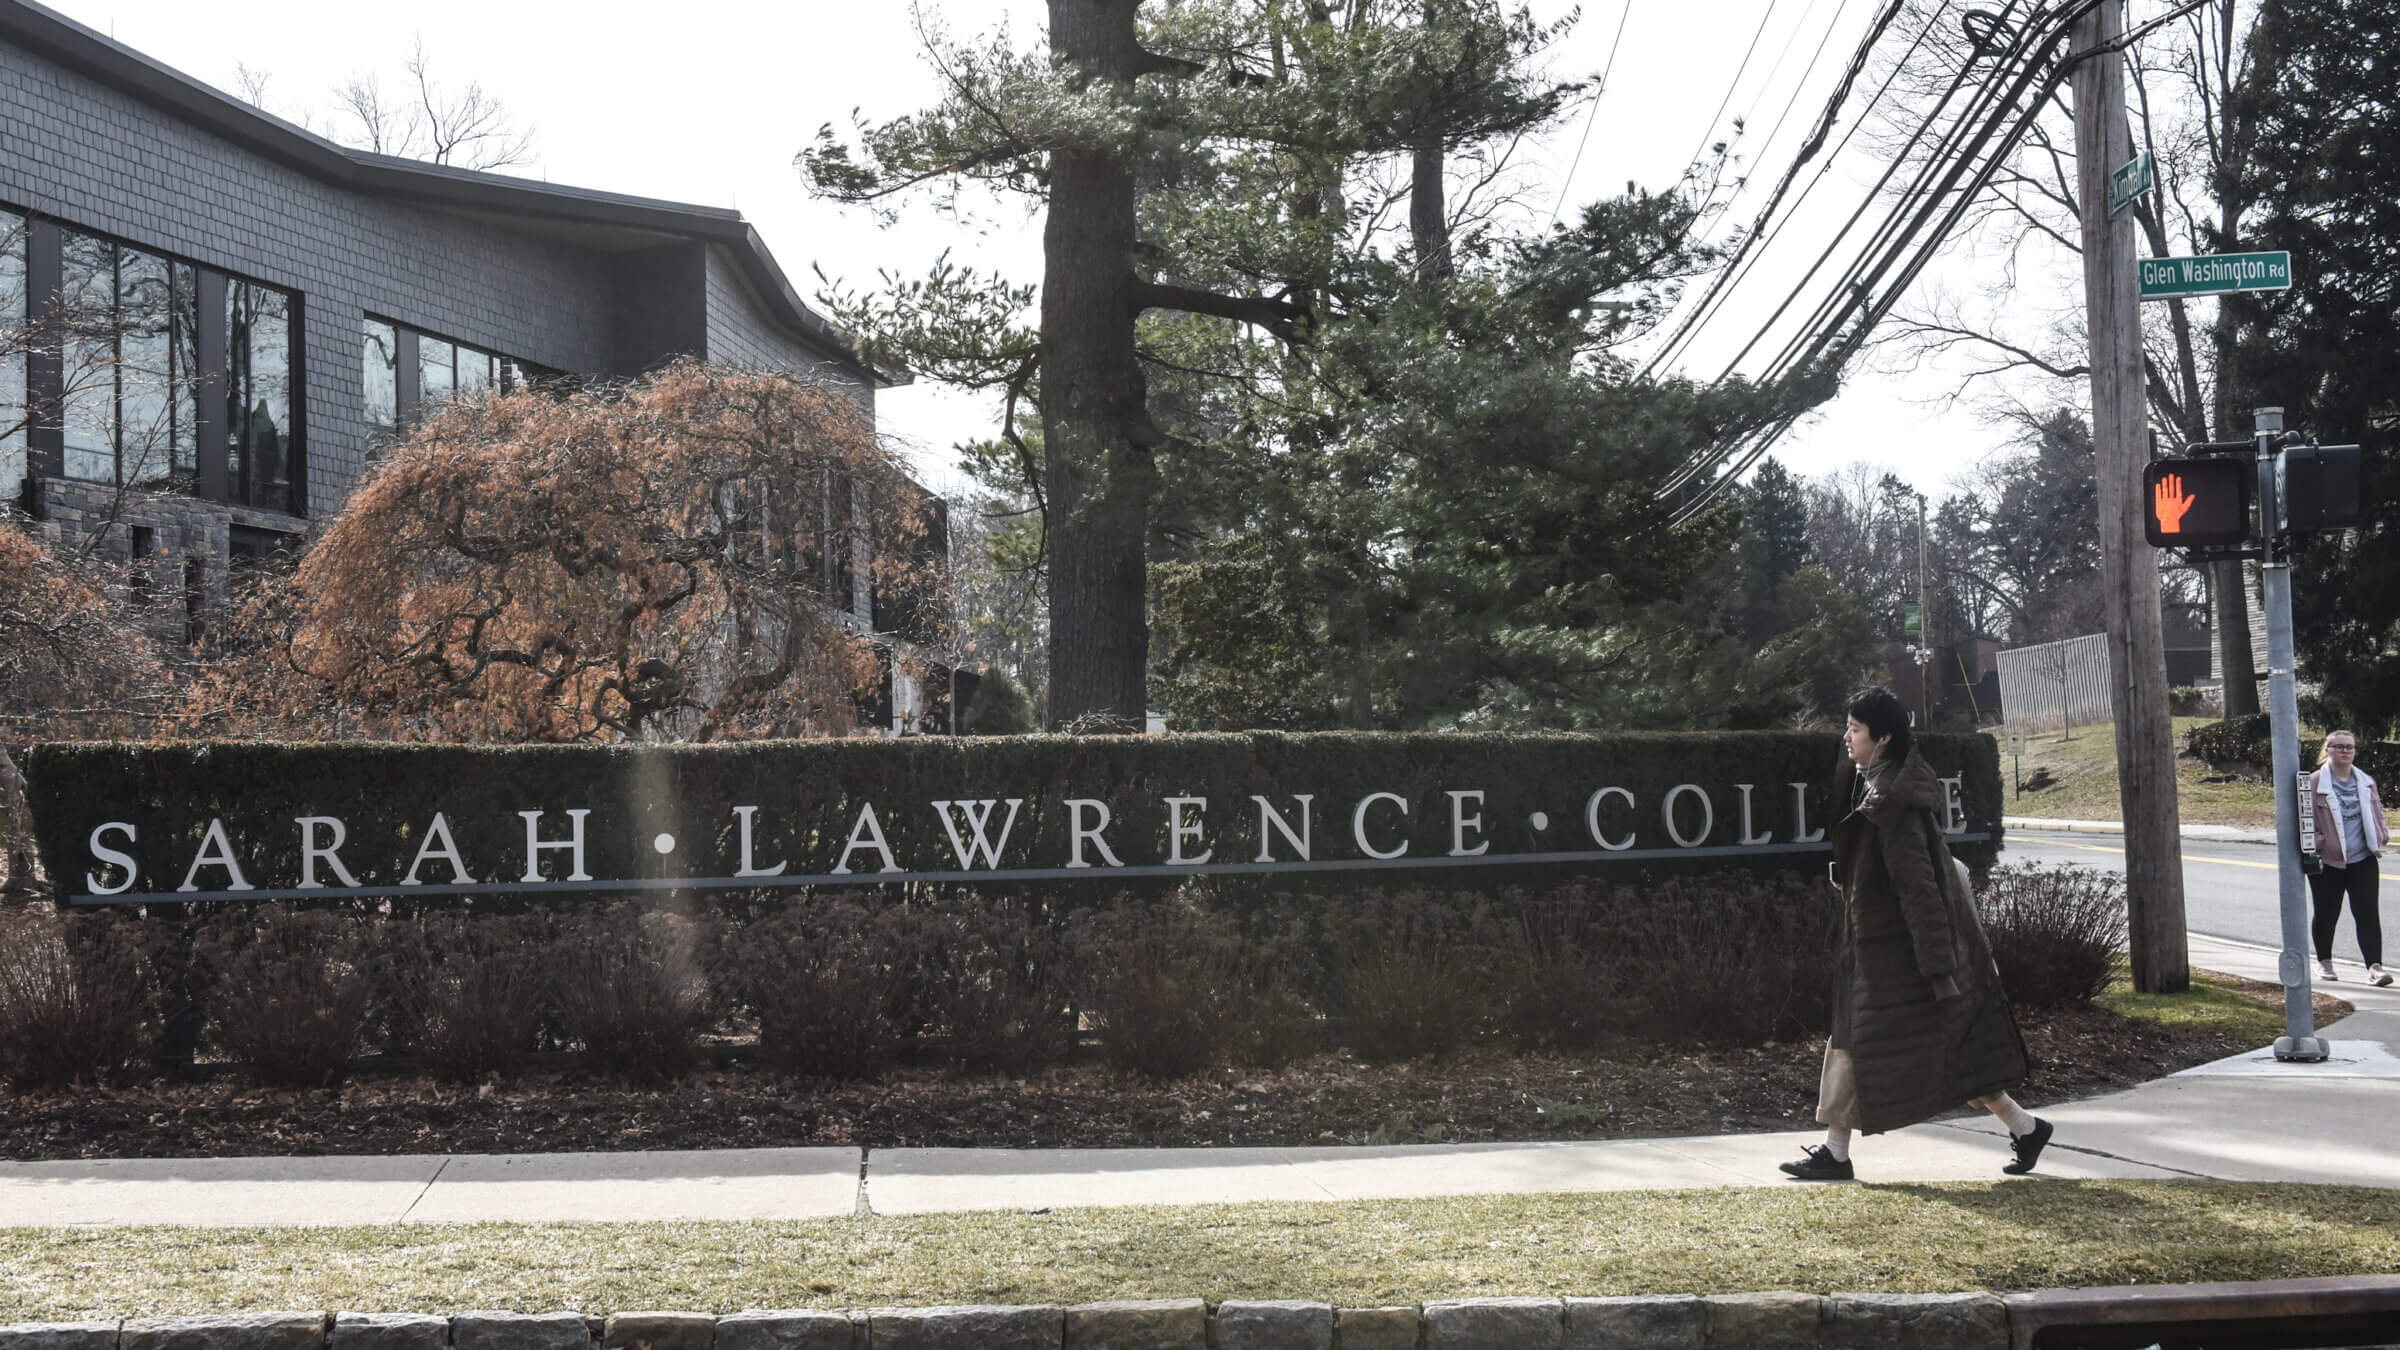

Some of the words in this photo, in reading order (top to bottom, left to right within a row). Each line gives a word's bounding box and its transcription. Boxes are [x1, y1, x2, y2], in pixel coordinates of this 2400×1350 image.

[2113, 166, 2143, 206] Kimball
[2143, 262, 2177, 285] Glen
[2181, 258, 2265, 288] Washington
[2269, 264, 2285, 278] Rd
[86, 808, 591, 895] SARAH
[732, 789, 1490, 878] LAWRENCE
[1585, 777, 1967, 851] COLLE
